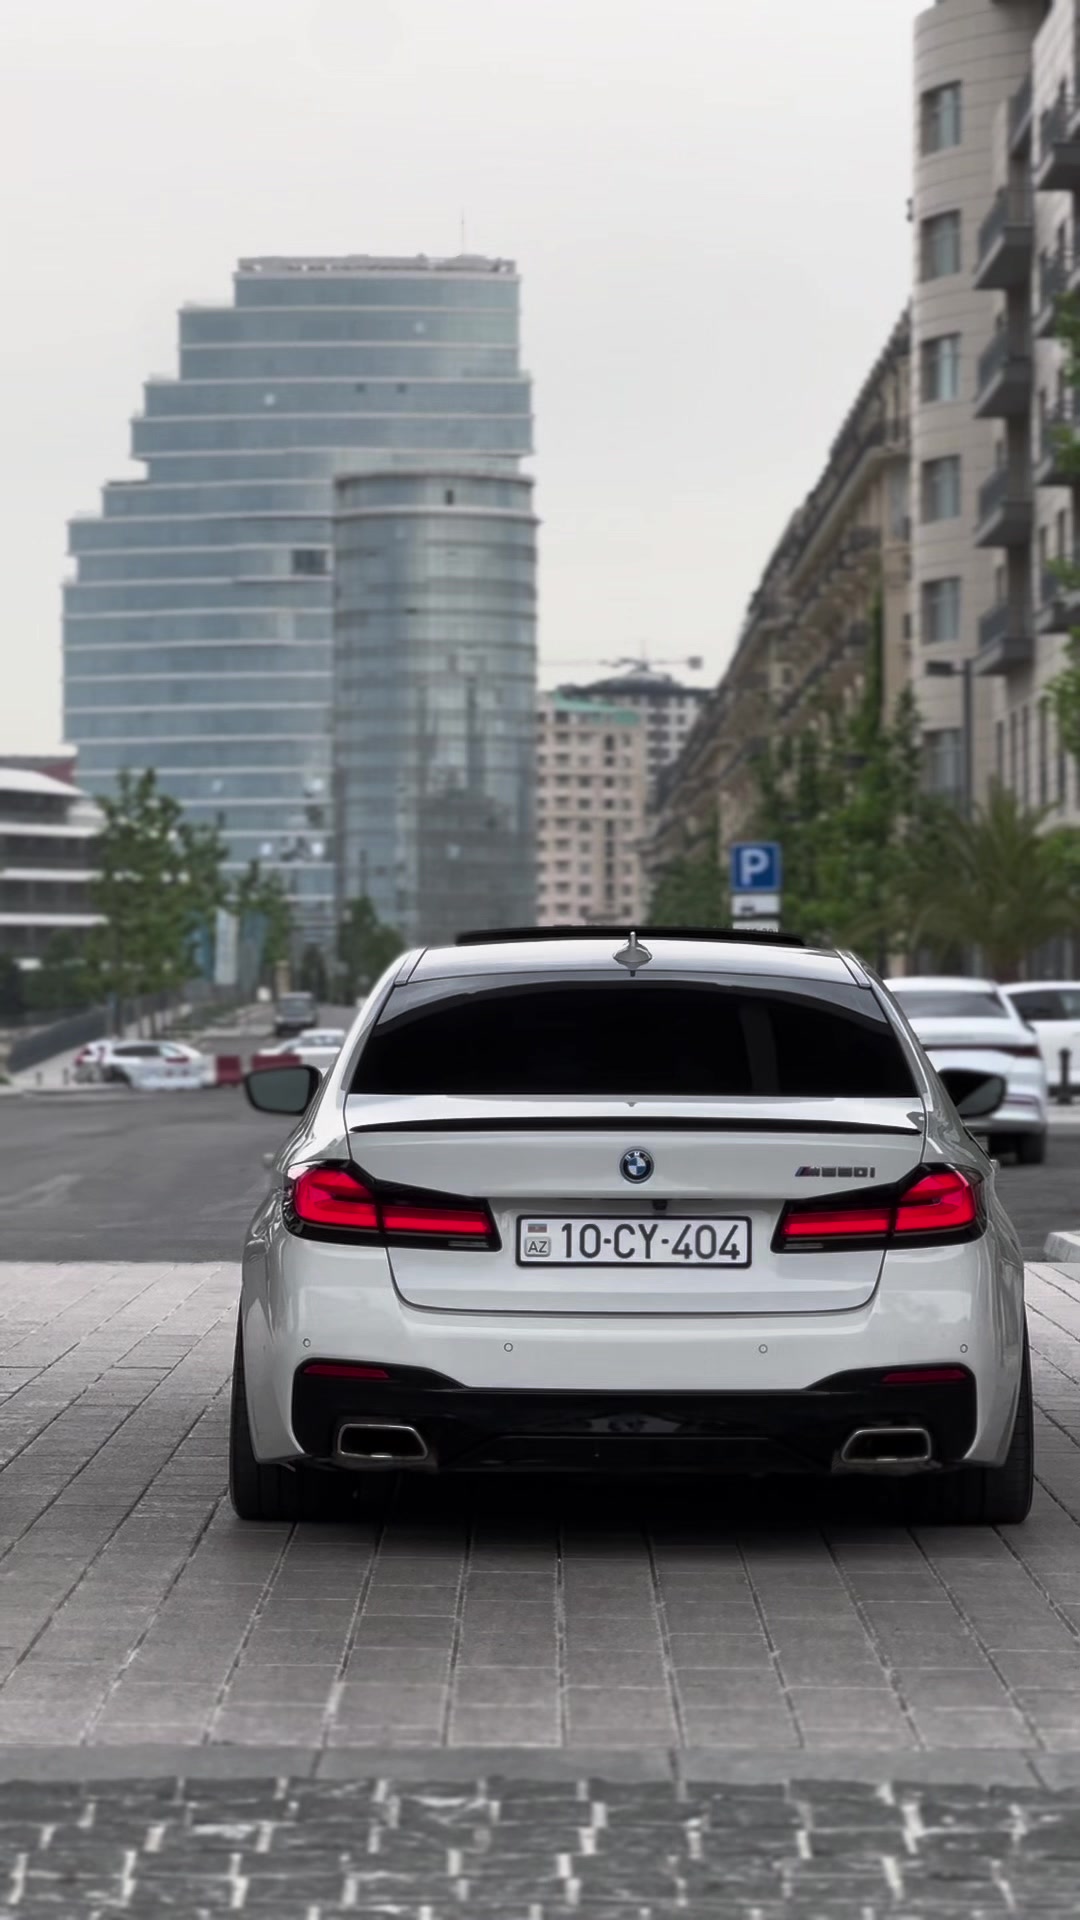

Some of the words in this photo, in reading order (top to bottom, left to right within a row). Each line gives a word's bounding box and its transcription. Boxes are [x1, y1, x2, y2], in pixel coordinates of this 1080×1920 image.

[741, 849, 769, 885] P
[528, 1240, 547, 1253] AZ
[561, 1223, 741, 1260] 10-CY-404
